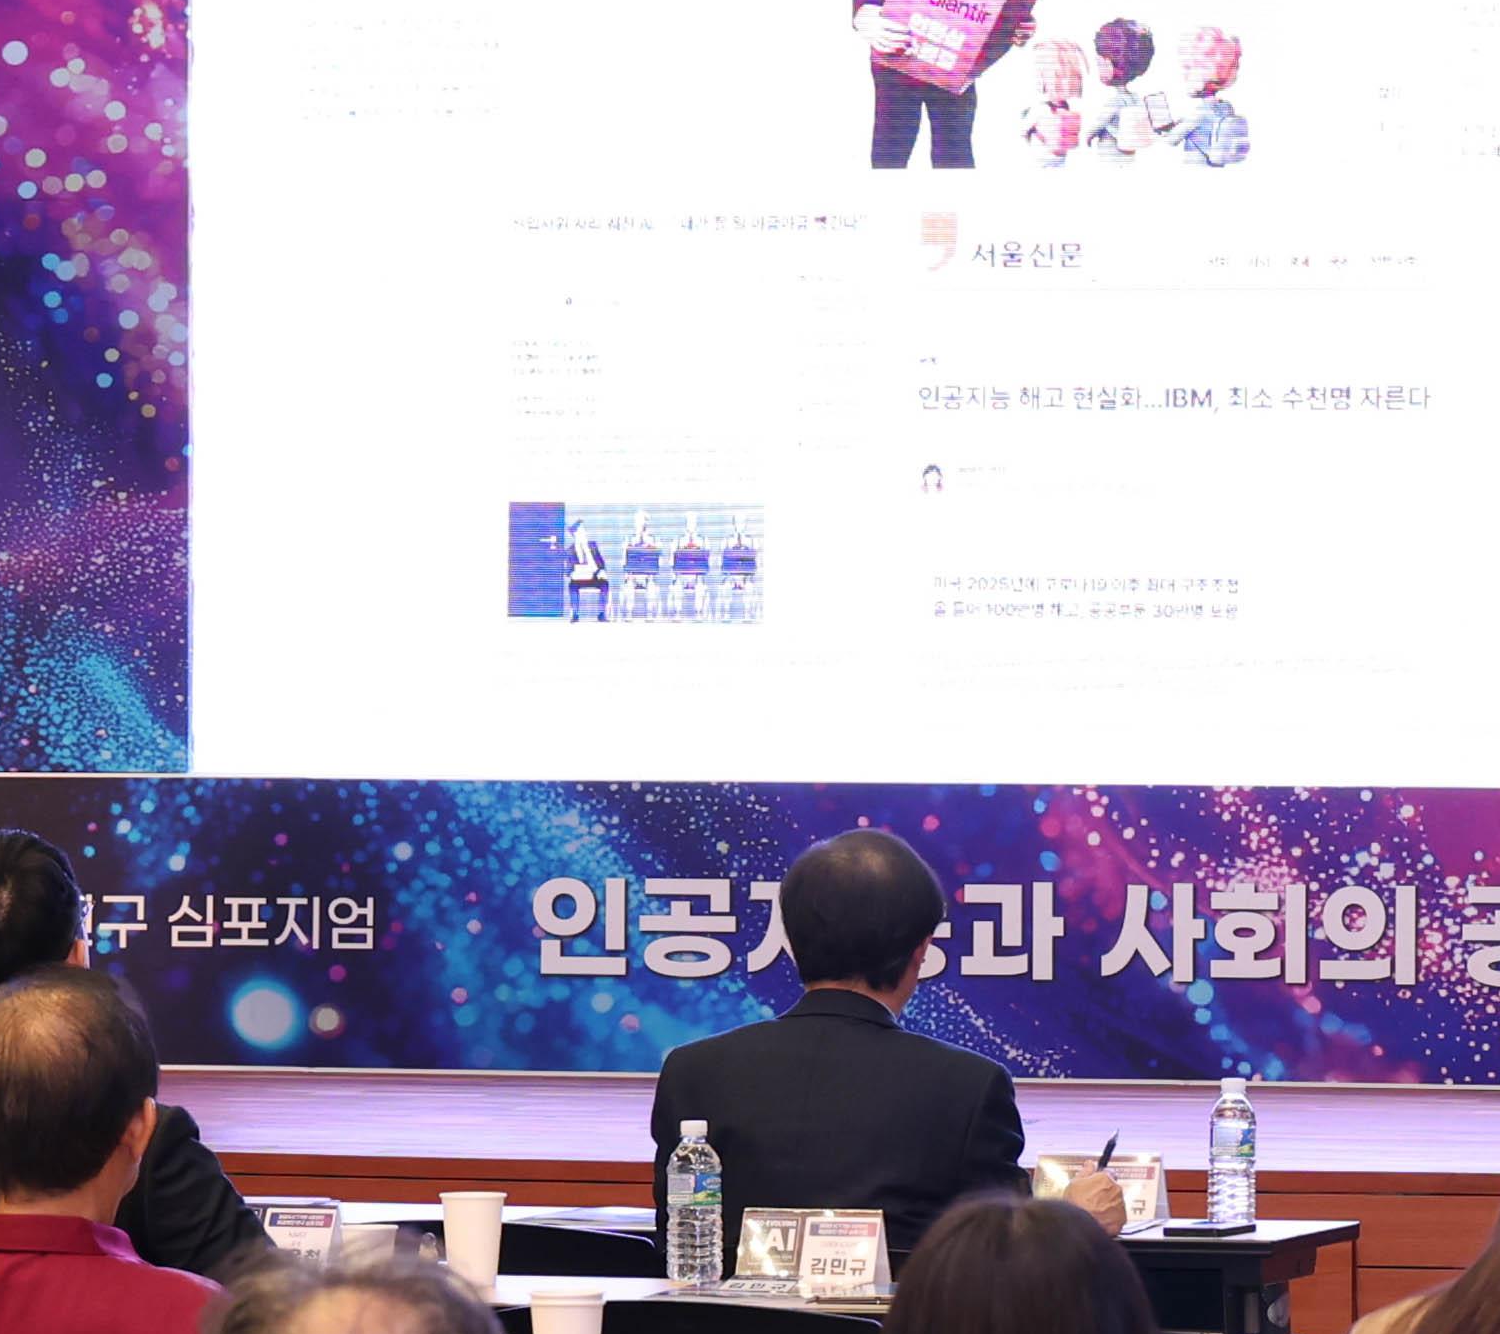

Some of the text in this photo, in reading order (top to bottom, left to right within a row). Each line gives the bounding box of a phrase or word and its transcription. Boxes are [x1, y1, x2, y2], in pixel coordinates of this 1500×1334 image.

[970, 240, 1084, 269] 서울신문
[917, 385, 1011, 410] 인공지능
[1018, 385, 1064, 410] 해고
[1227, 385, 1273, 410] 최소
[1281, 385, 1352, 410] 수천명
[1359, 384, 1431, 410] 자른다
[167, 893, 375, 951] 심포지엄
[531, 875, 1065, 981] 인공과
[1100, 879, 1417, 984] 사회의
[765, 1228, 795, 1252] AI
[810, 1257, 867, 1276] 김민규
